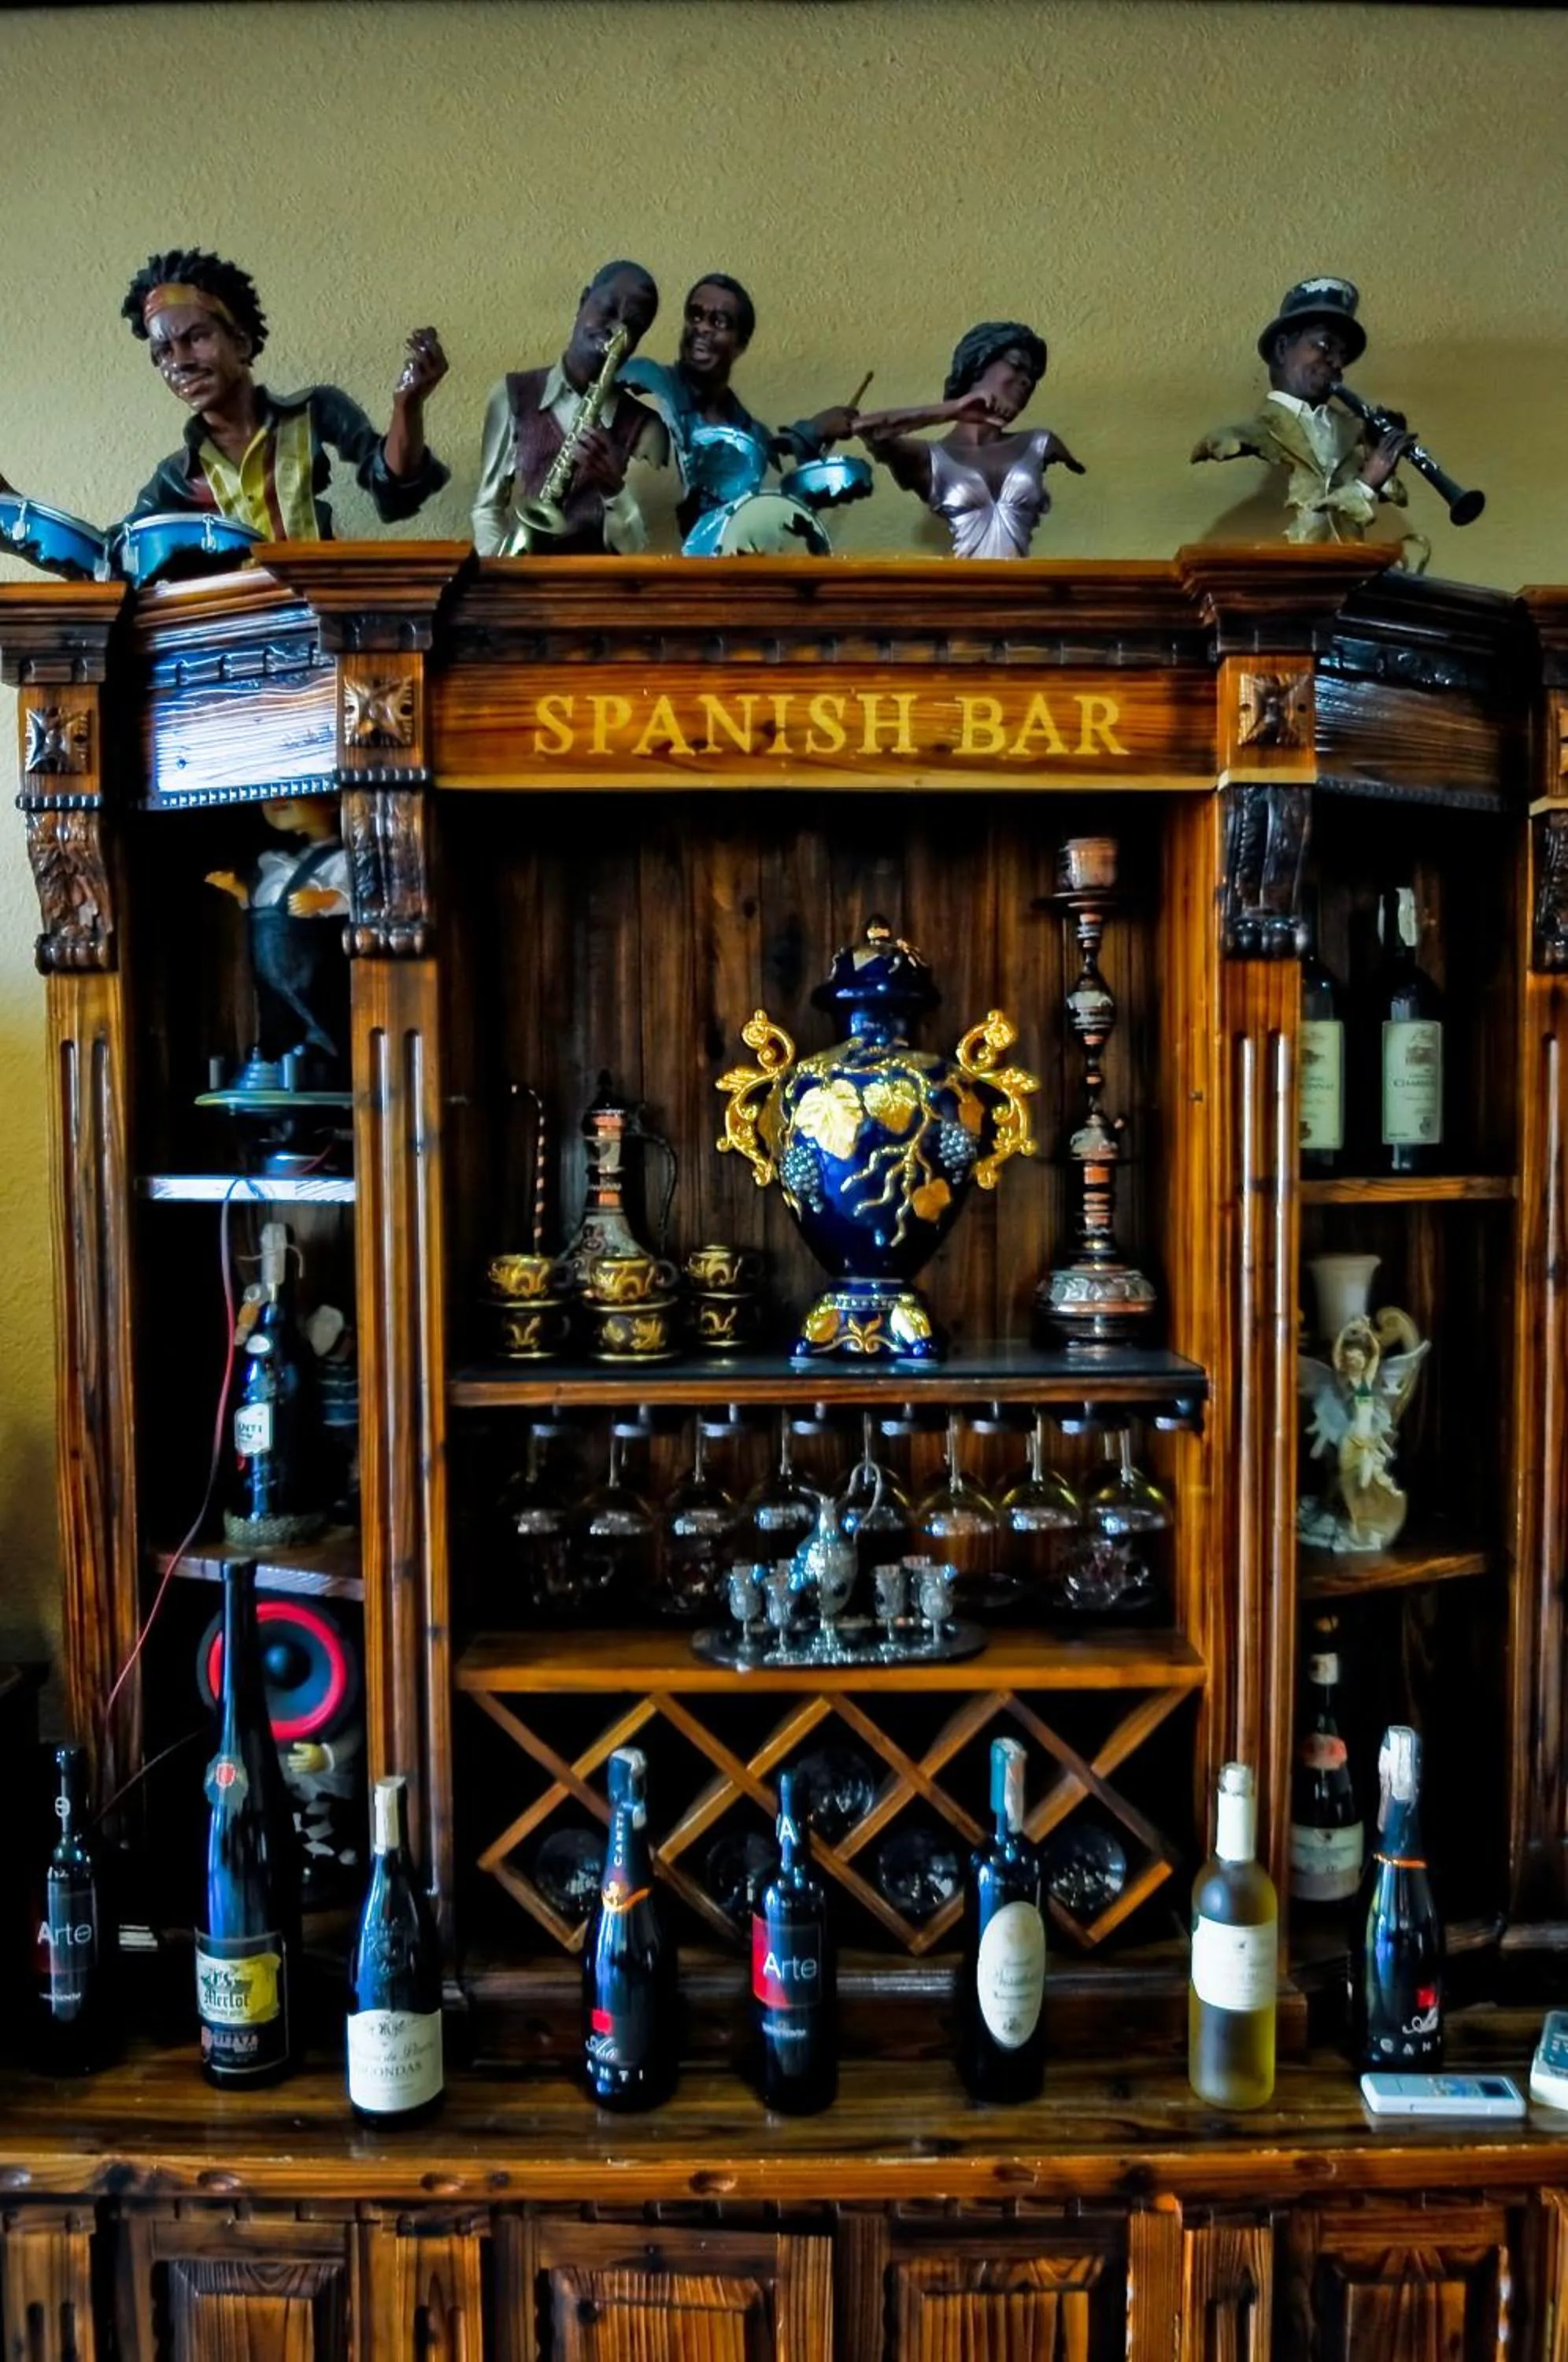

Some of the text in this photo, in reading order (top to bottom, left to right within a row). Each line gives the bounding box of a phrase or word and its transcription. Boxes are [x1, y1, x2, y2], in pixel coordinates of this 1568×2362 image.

[534, 693, 1130, 756] SPANISH BAR
[613, 1811, 624, 1867] CANTI
[37, 1920, 93, 1946] Arte
[762, 1951, 818, 1982] Arte
[204, 1986, 252, 2008] Merlot
